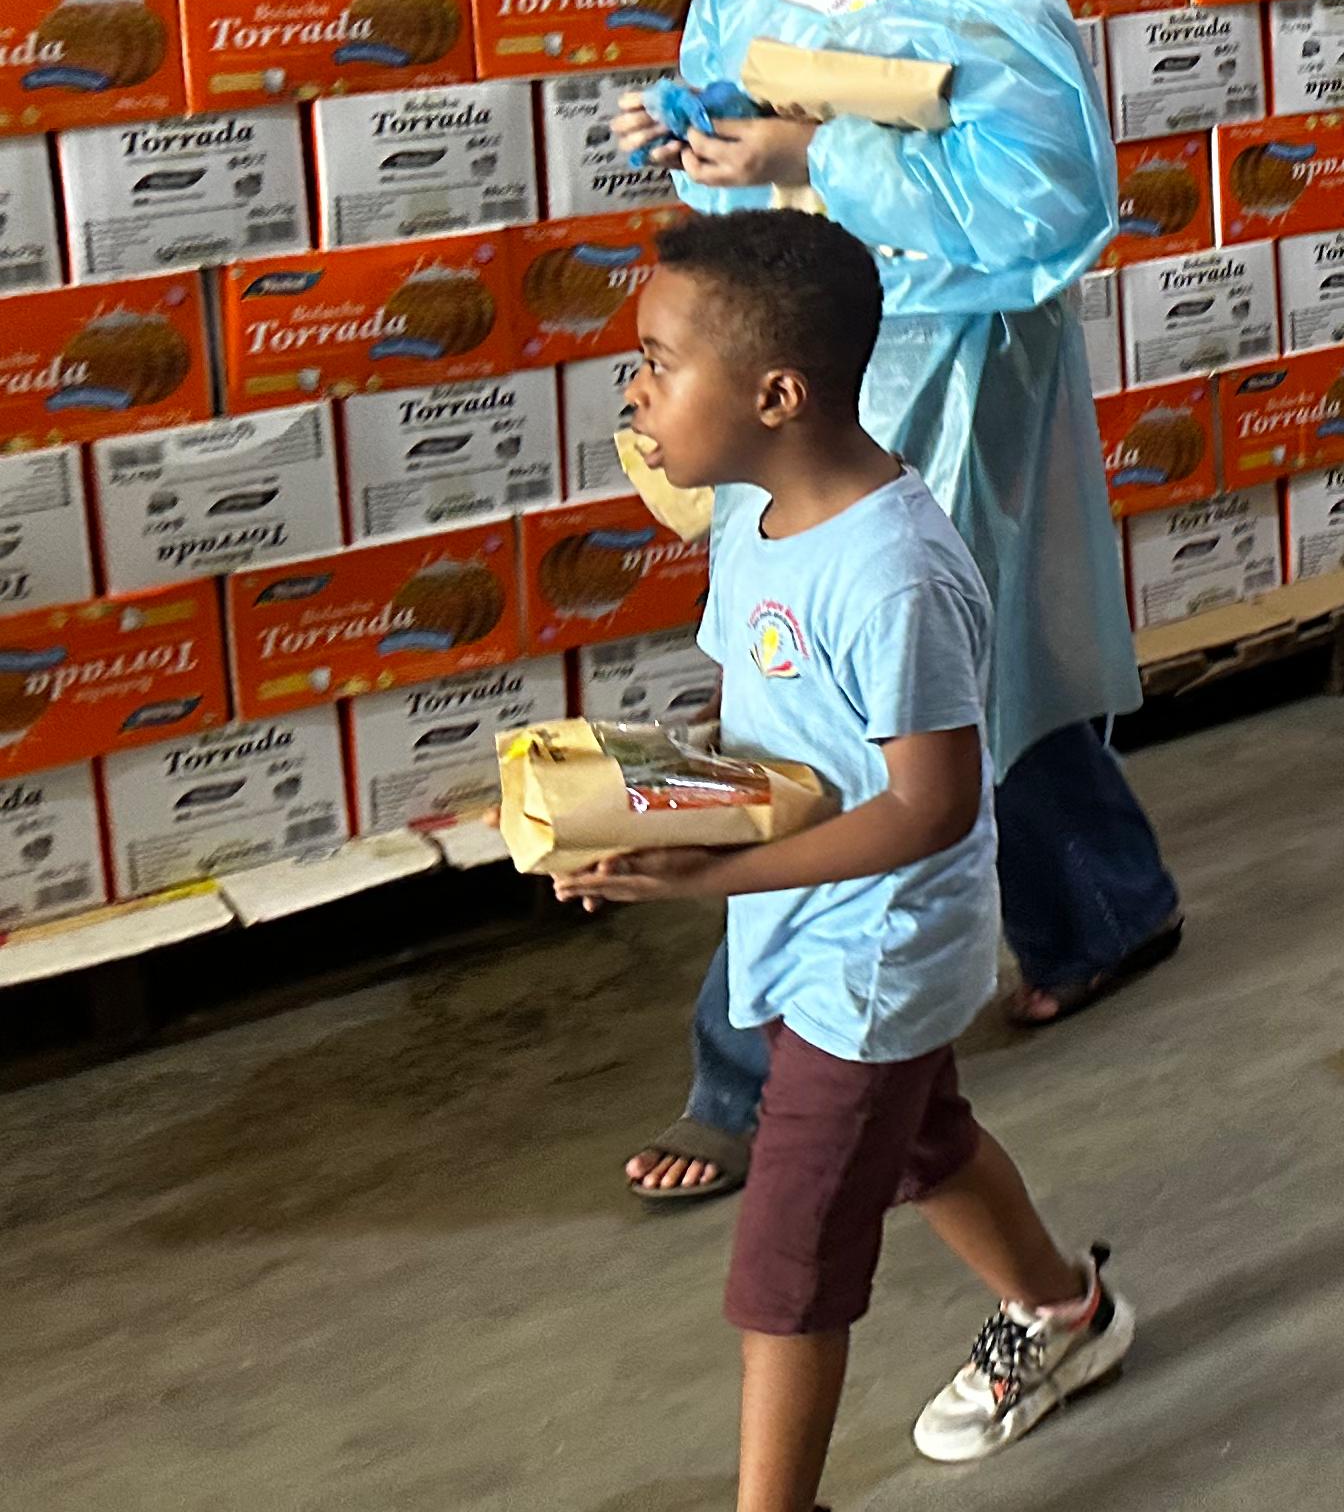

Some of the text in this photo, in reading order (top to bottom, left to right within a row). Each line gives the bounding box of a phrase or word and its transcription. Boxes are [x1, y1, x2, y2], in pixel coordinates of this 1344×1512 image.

[209, 12, 375, 51] Torrada
[1146, 18, 1232, 44] Torrada
[121, 123, 255, 156] Torrada
[370, 106, 493, 137] Torrada
[1160, 260, 1245, 291] Torrada
[245, 311, 408, 354] Torrada
[400, 390, 517, 426] Torrada
[1238, 398, 1340, 438] Torrada
[157, 521, 290, 563] Torrada
[258, 606, 416, 659] Torrada
[25, 641, 199, 698] Torrada
[406, 674, 524, 717] Torrada
[165, 725, 295, 776] Torrada
